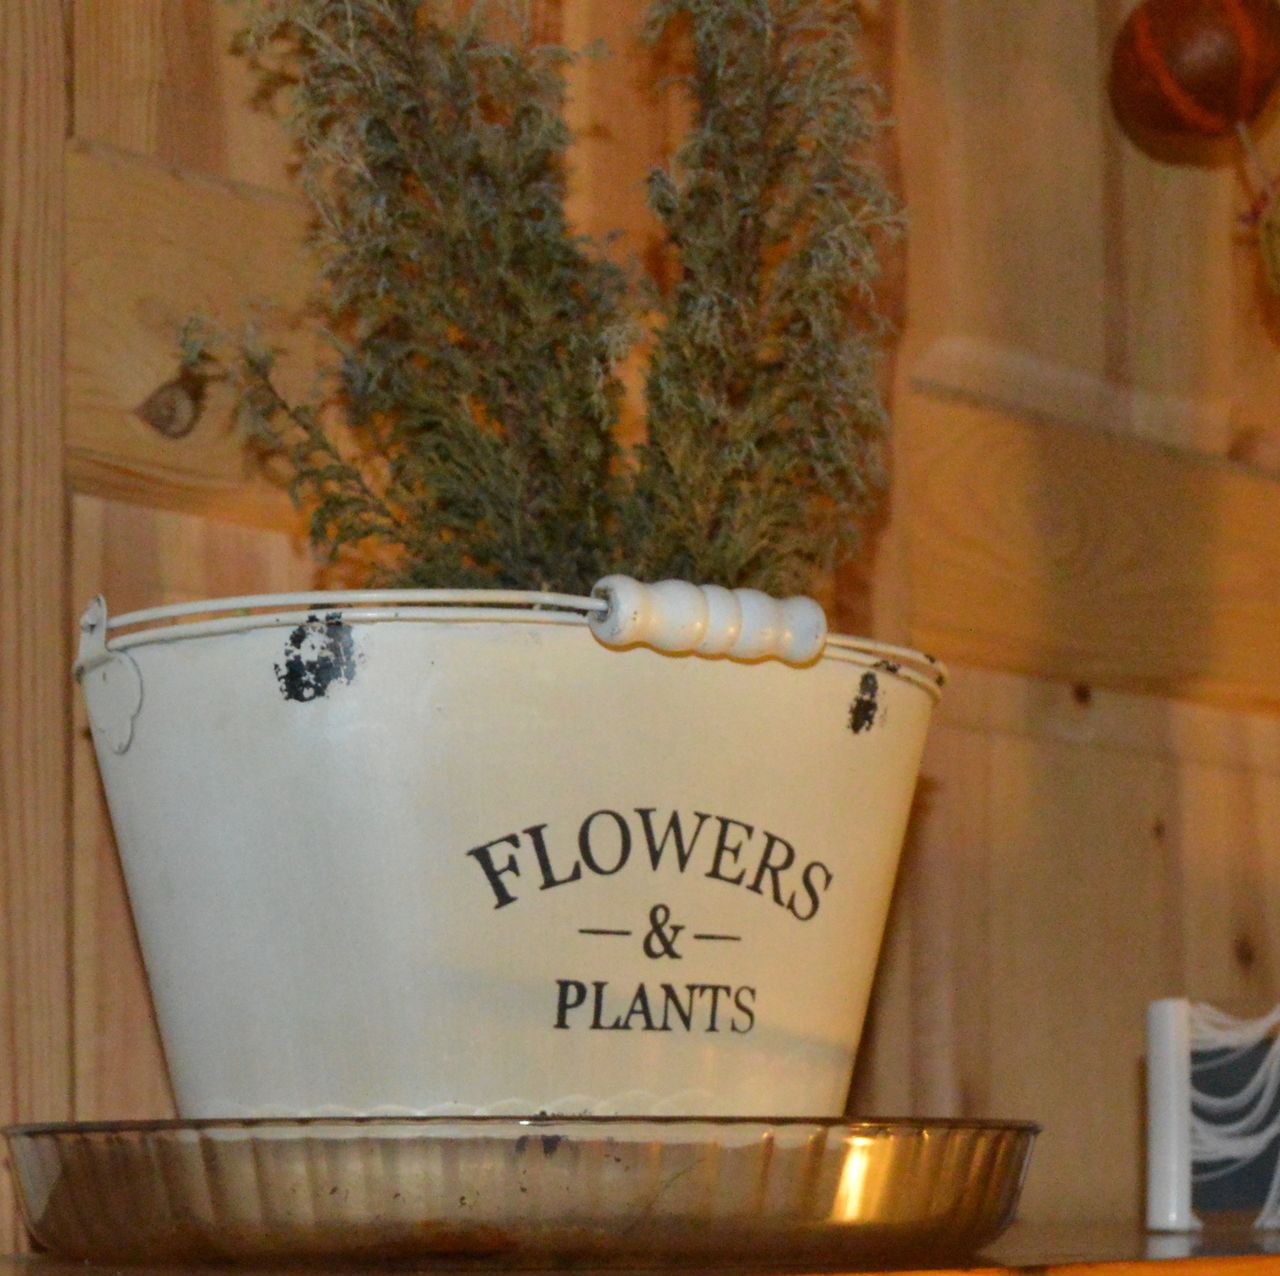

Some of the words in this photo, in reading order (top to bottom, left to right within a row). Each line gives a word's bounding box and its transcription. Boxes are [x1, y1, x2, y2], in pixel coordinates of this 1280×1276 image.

[466, 807, 834, 922] FLOWERS
[642, 903, 686, 960] &
[553, 979, 757, 1034] PLANTS
